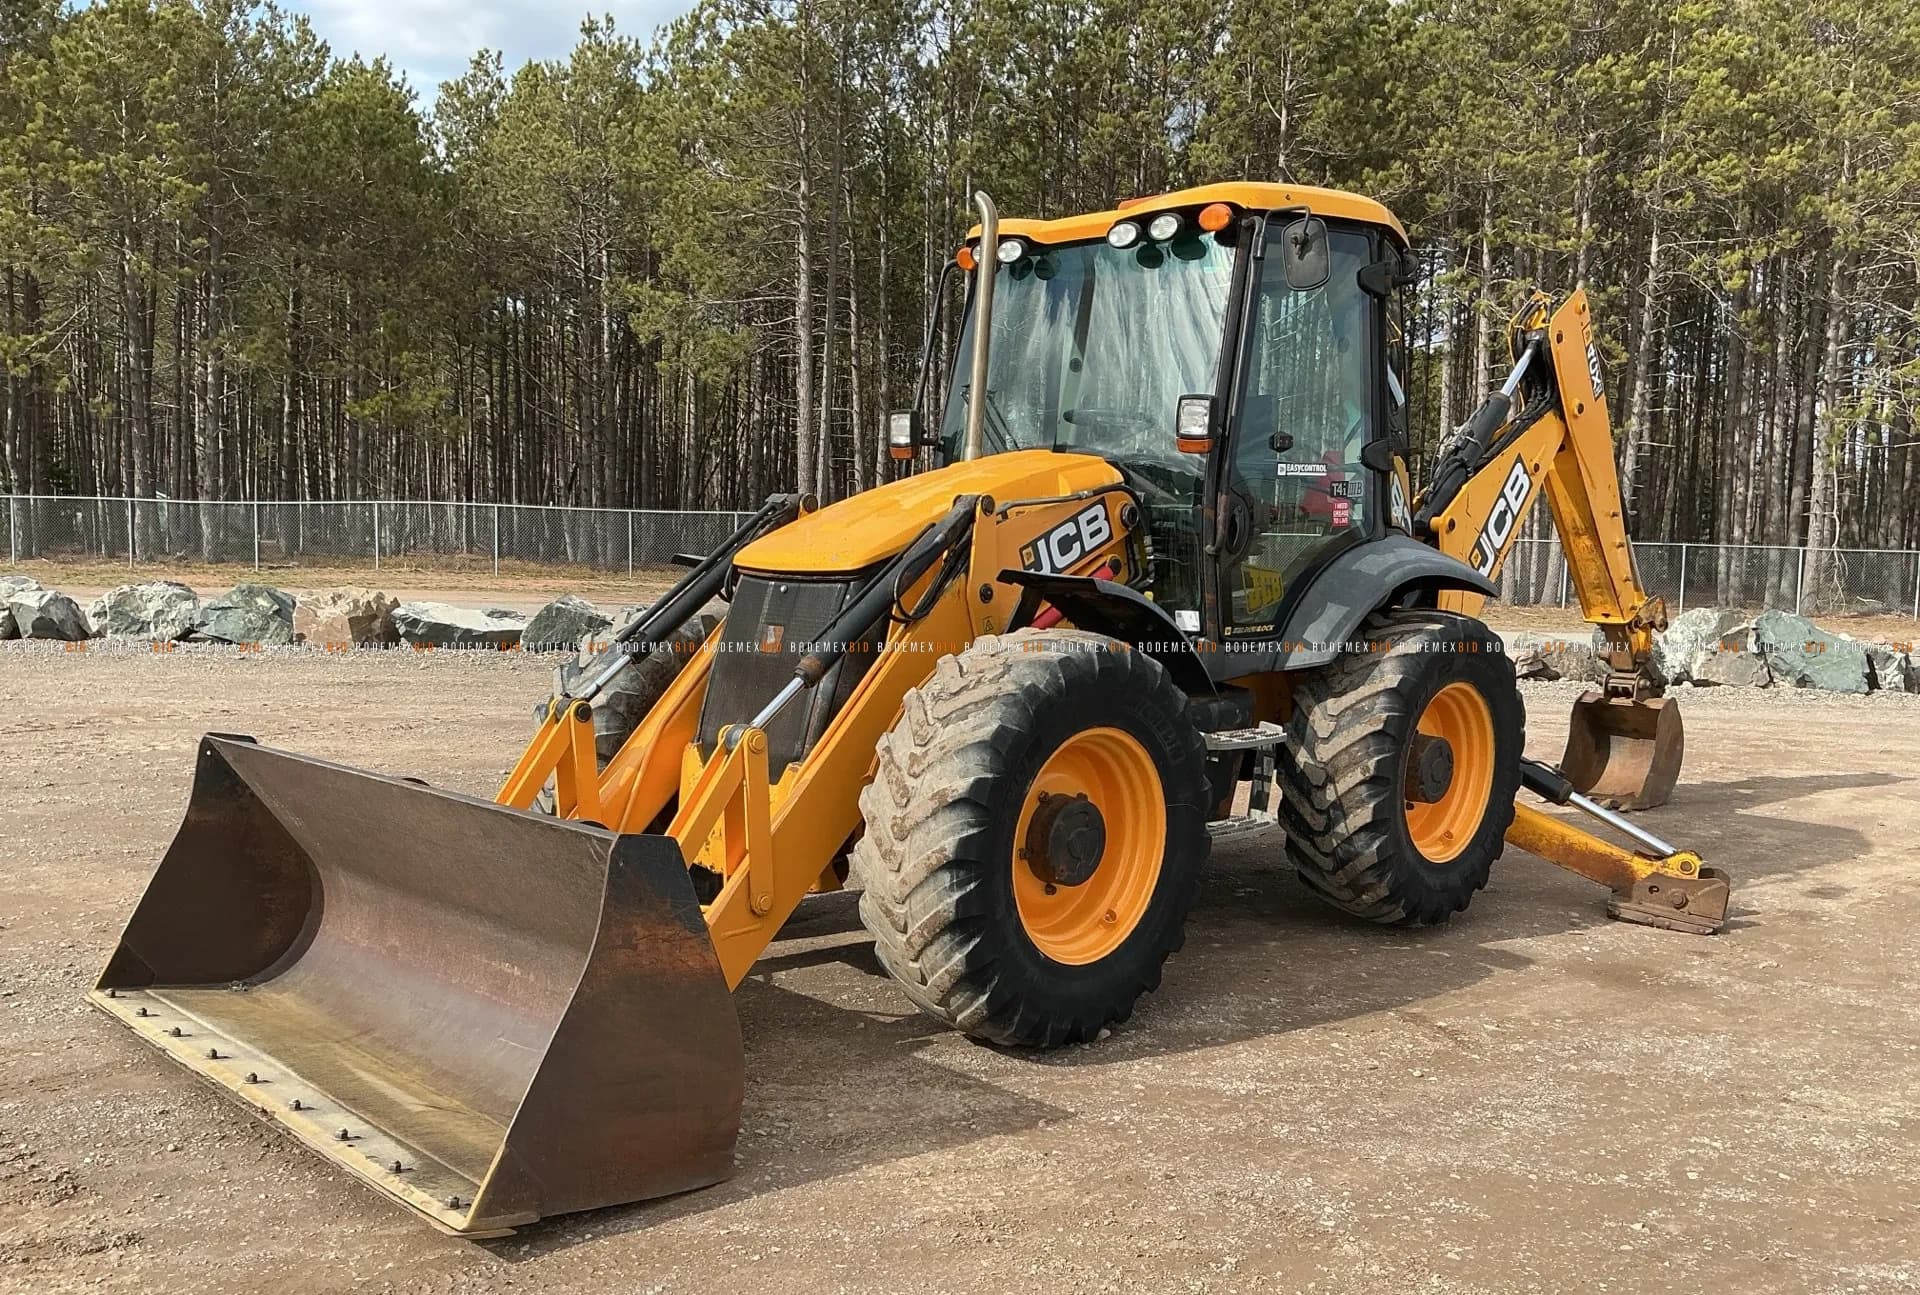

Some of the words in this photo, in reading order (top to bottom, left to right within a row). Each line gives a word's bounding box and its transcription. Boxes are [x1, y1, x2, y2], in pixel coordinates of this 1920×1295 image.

[1287, 463, 1328, 474] EASYCONTROL
[1026, 504, 1111, 575] JCB
[1479, 462, 1531, 578] JCB
